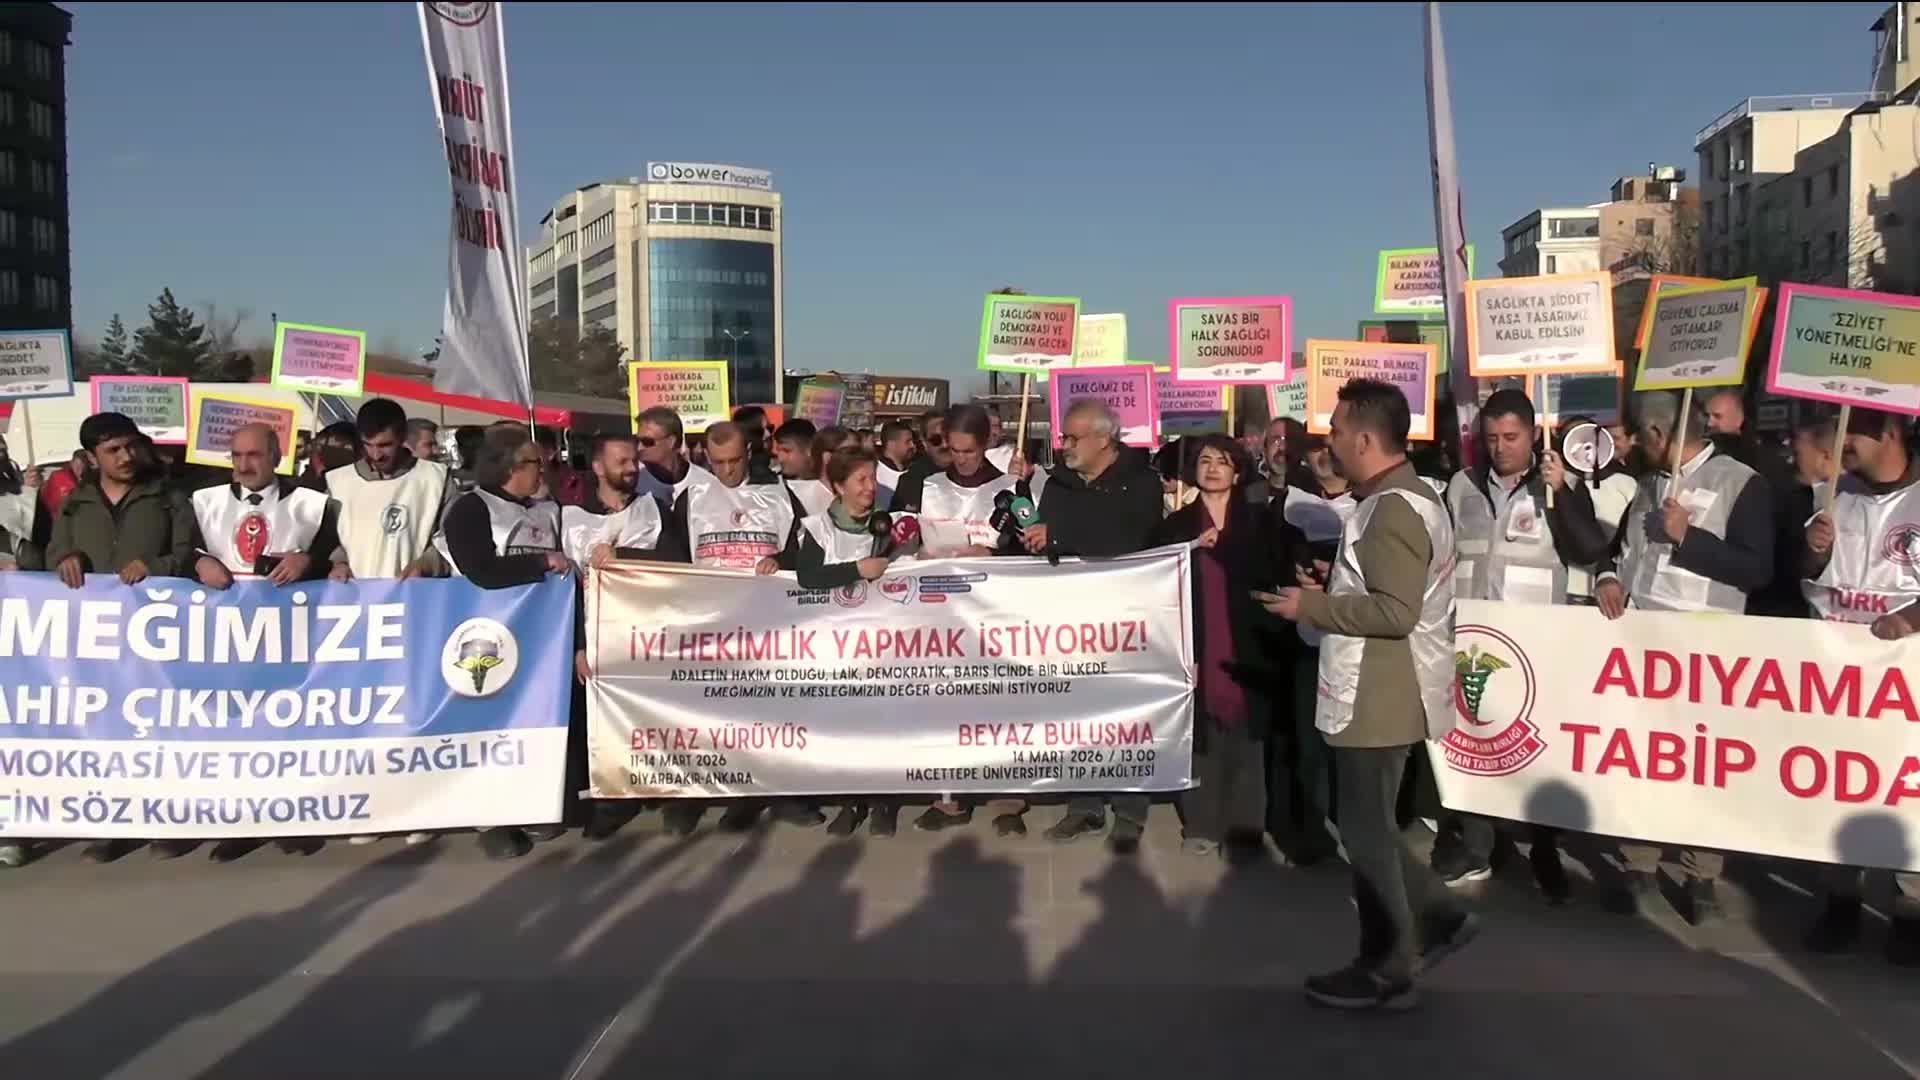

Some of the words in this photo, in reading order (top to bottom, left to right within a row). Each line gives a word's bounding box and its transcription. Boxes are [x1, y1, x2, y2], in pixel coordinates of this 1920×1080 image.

[671, 164, 728, 181] bower
[730, 171, 769, 188] hospital
[1044, 311, 1067, 322] YOLU
[1242, 311, 1260, 325] BİR
[1053, 325, 1064, 336] VE
[1191, 329, 1220, 341] HALK
[1495, 328, 1534, 341] KABUL
[1197, 345, 1264, 357] SORUNUDUR
[1830, 352, 1872, 369] HAYIR
[1122, 381, 1135, 392] DE
[1124, 397, 1136, 408] DE
[1830, 584, 1888, 613] TÜRK
[0, 589, 405, 664] MEĞİMİZE
[630, 626, 667, 661] İYİ
[679, 625, 816, 661] HEKİMLİK
[832, 627, 965, 660] YAPMAK
[979, 620, 1147, 657] İSTİYORUZ!
[671, 668, 727, 681] ADALETİN
[731, 667, 770, 681] HAKİM
[1039, 663, 1057, 677] BİR
[1063, 661, 1109, 676] ÜLKEDE
[704, 685, 776, 698] EMEĞİMİZİN
[781, 686, 795, 698] VE
[890, 683, 930, 697] DEĞER
[935, 681, 1003, 696] GÖRMESİNİ
[1008, 681, 1072, 695] İSTİYORUZ
[1592, 647, 1920, 722] ADIYAMA
[122, 686, 406, 738] ÇIKIYORUZ
[631, 728, 699, 751] BEYAZ
[709, 723, 808, 751] YÜRÜYÜŞ
[958, 723, 1034, 747] BEYAZ
[174, 751, 219, 779] VE
[228, 748, 375, 778] TOPLUM
[386, 733, 525, 774] SAĞLIĞI
[630, 754, 655, 767] 11-14
[660, 754, 691, 767] MART
[697, 754, 727, 767] 2026
[1013, 751, 1025, 763] 14
[1029, 751, 1065, 763] MART
[1070, 750, 1103, 763] 2026
[1500, 746, 1529, 768] ODASI
[1560, 722, 1757, 788] TABİP
[630, 772, 753, 785] DİYARBAKIR-ANKARA
[906, 767, 977, 781] HACETTEPE
[983, 765, 1063, 780] ÜNİVERSİTESİ
[1069, 766, 1086, 780] TIP
[1091, 764, 1155, 779] FAKÜLTESİ
[61, 791, 133, 823] SÖZ
[143, 794, 370, 824] KURUYORUZ
